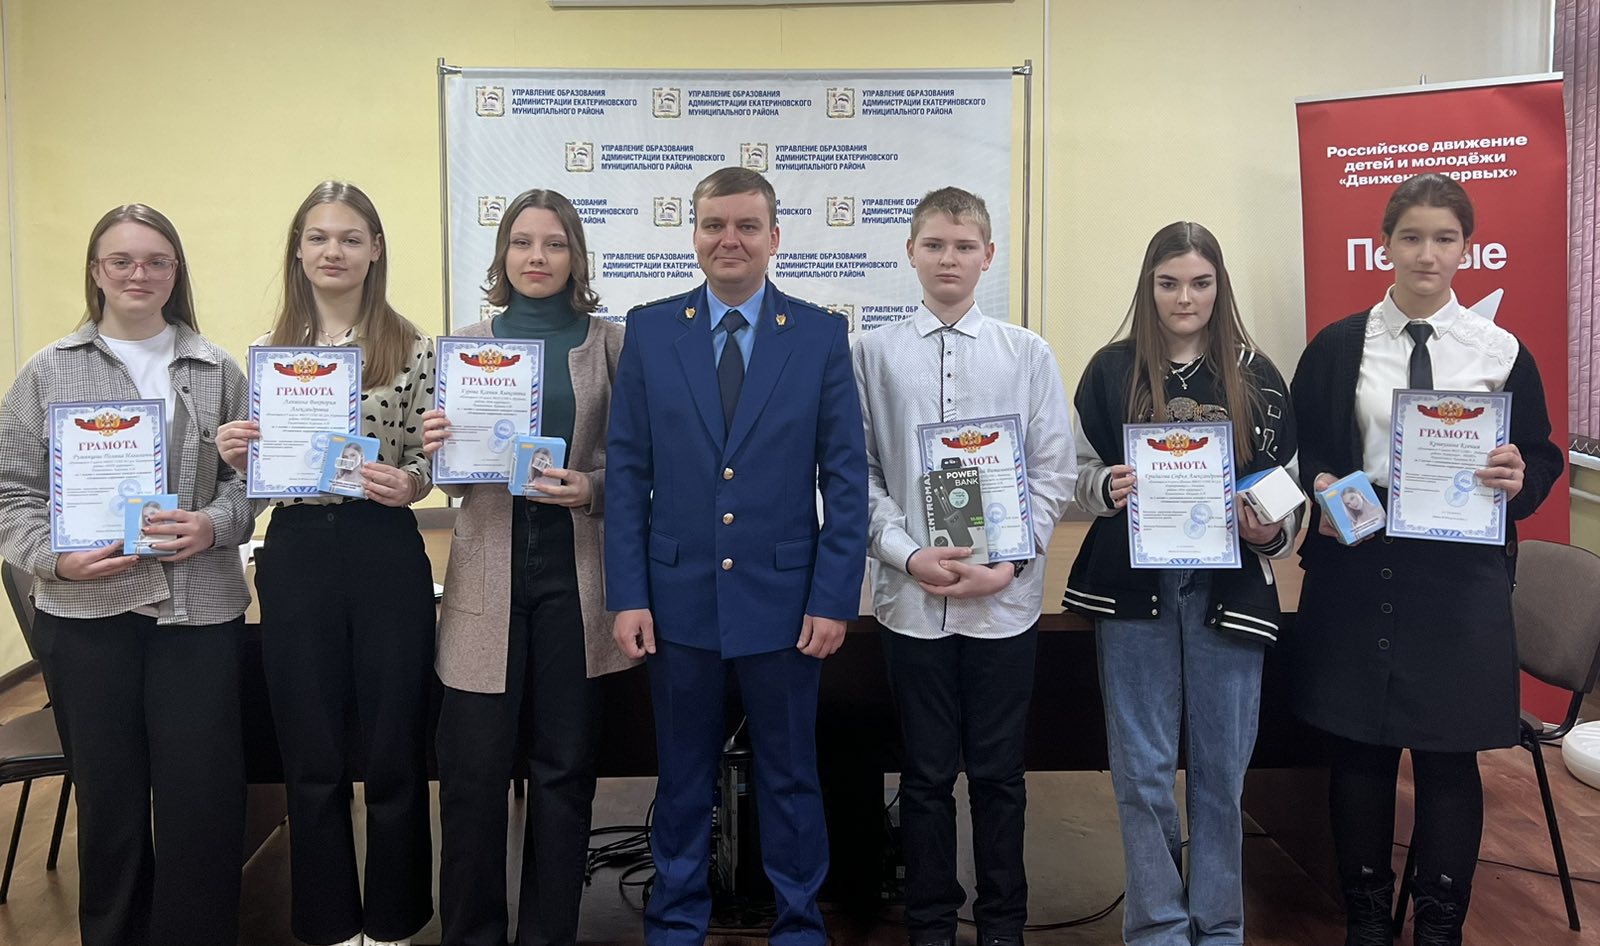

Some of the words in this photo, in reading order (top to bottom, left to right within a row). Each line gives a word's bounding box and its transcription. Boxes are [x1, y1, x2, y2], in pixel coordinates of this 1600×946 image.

[512, 89, 555, 97] УПРАВЛЕНИЕ
[557, 89, 605, 97] ОБРАЗОВАНИЯ
[688, 90, 731, 98] УПРАВЛЕНИЕ
[732, 90, 780, 98] ОБРАЗОВАНИЯ
[862, 89, 905, 97] УПРАВЛЕНИЕ
[906, 89, 954, 97] ОБРАЗОВАНИЯ
[512, 98, 572, 106] АДМИНИСТРАЦИИ
[574, 98, 637, 106] ЕКАТЕРИНОВСКОГО
[862, 98, 921, 106] АДМИНИСТРАЦИИ
[923, 98, 986, 106] ЕКАТЕРИНОВСКОГО
[688, 108, 751, 116] МУНИЦИПАЛЬНОГО
[752, 108, 779, 116] РАЙОНА
[862, 108, 925, 116] МУНИЦИПАЛЬНОГО
[1327, 143, 1429, 158] Российское
[1432, 135, 1528, 154] движение
[601, 154, 660, 162] АДМИНИСТРАЦИИ
[776, 154, 834, 162] АДМИНИСТРАЦИИ
[1344, 158, 1394, 173] детей
[1398, 158, 1408, 168] и
[1411, 152, 1506, 168] молодёжи
[601, 163, 664, 171] МУНИЦИПАЛЬНОГО
[776, 163, 838, 171] МУНИЦИПАЛЬНОГО
[603, 262, 661, 270] АДМИНИСТРАЦИИ
[776, 262, 834, 270] АДМИНИСТРАЦИИ
[603, 271, 665, 279] МУНИЦИПАЛЬНОГО
[776, 270, 838, 278] МУНИЦИПАЛЬНОГО
[839, 270, 865, 278] РАЙОНА
[461, 377, 517, 387] ГРАМОТА
[276, 387, 334, 396] ГРАМОТА
[1419, 428, 1479, 440] ГРАМОТА
[79, 440, 138, 451] ГРАМОТА
[1152, 460, 1207, 470] ГРАМОТА
[946, 470, 978, 480] POWER
